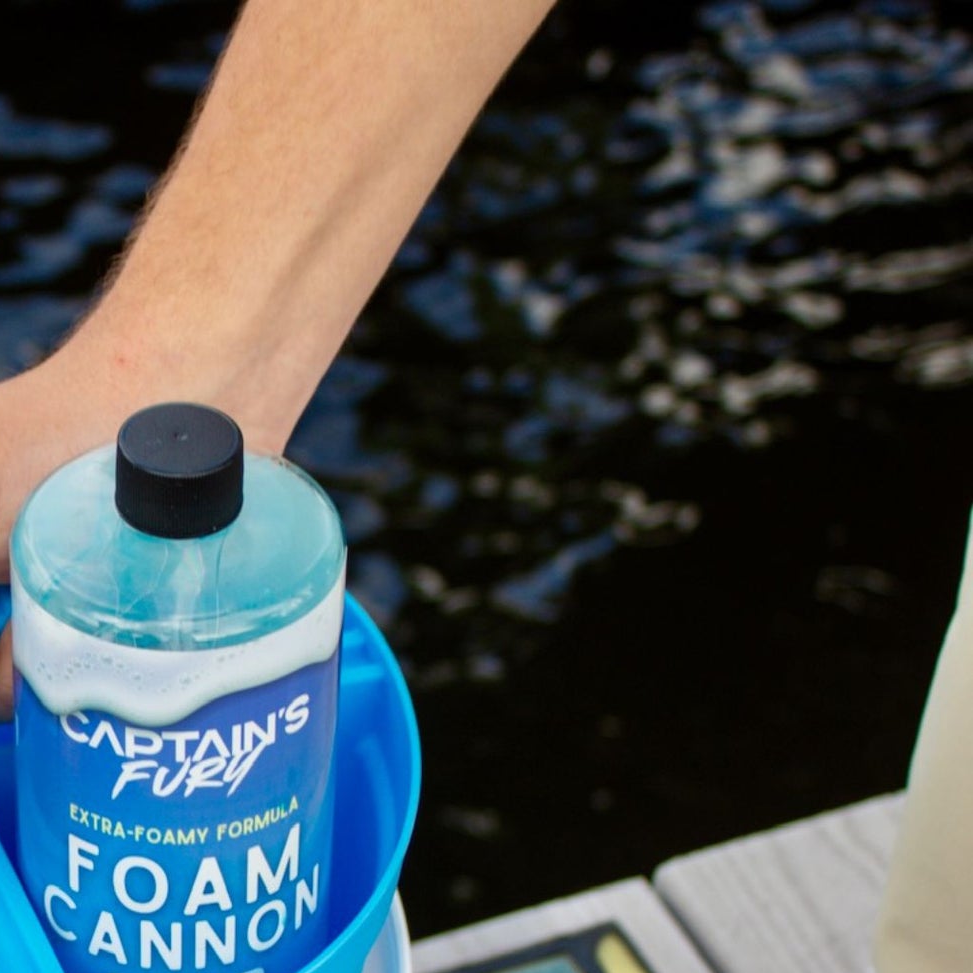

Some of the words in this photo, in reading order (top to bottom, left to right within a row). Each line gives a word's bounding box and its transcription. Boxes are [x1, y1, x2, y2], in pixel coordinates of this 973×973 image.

[59, 693, 310, 763] CAPTAIN'S
[111, 741, 269, 800] FURY
[69, 803, 209, 845] EXTRA-FOAMY
[216, 795, 299, 841] FORMULA
[68, 822, 300, 916] FOAM
[44, 863, 319, 971] CANNON
